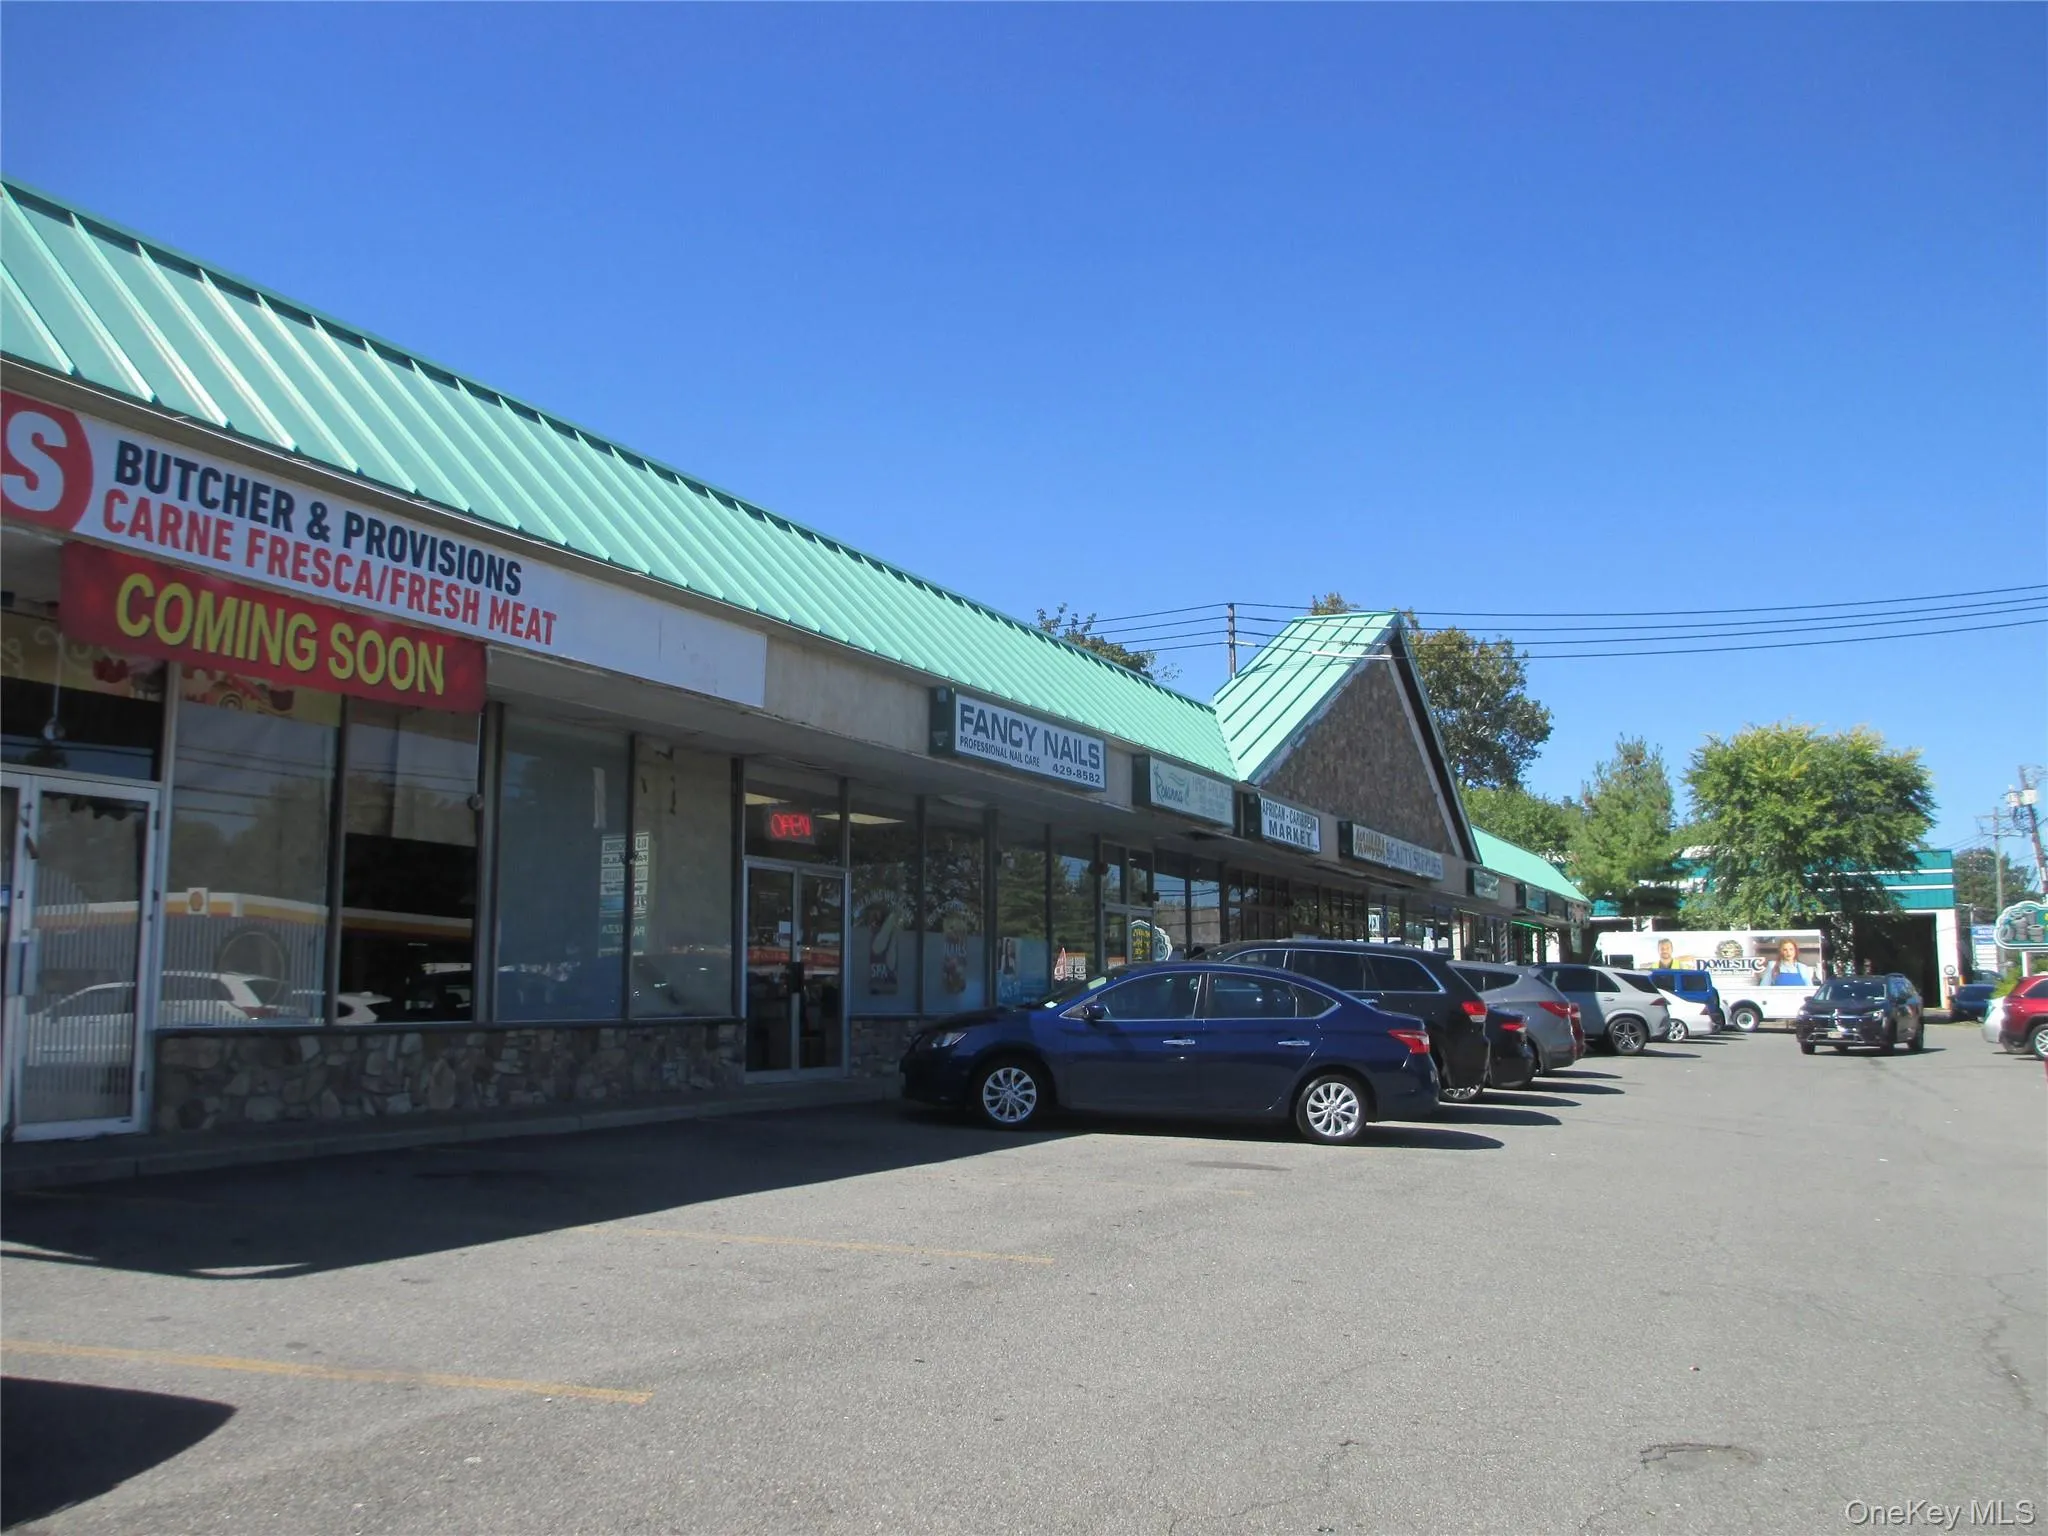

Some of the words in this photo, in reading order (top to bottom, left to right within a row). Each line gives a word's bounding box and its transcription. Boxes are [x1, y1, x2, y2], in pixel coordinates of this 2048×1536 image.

[2, 410, 68, 512] S
[115, 440, 295, 533] BUTCHER
[306, 500, 331, 543] &
[343, 514, 523, 597] PROVISIONS
[103, 489, 233, 562] CARNE
[246, 528, 480, 626] FRESCA/FRESH
[488, 595, 557, 646] MEAT
[116, 572, 318, 673] COMING
[328, 621, 445, 697] SOON
[960, 703, 1038, 752] FANCY
[1043, 729, 1101, 770] NAILS
[960, 735, 1009, 760] PROFESSIONAL
[1009, 749, 1024, 764] NAIL
[1024, 754, 1041, 768] CARE
[1052, 763, 1101, 784] 429-8582
[771, 813, 811, 838] OPEN
[1262, 799, 1286, 822] AFRICAN
[1289, 809, 1317, 832] CARIBBEAN
[1269, 820, 1312, 846] MARKET
[870, 963, 889, 979] SPA
[1695, 957, 1767, 973] DOMESTIC
